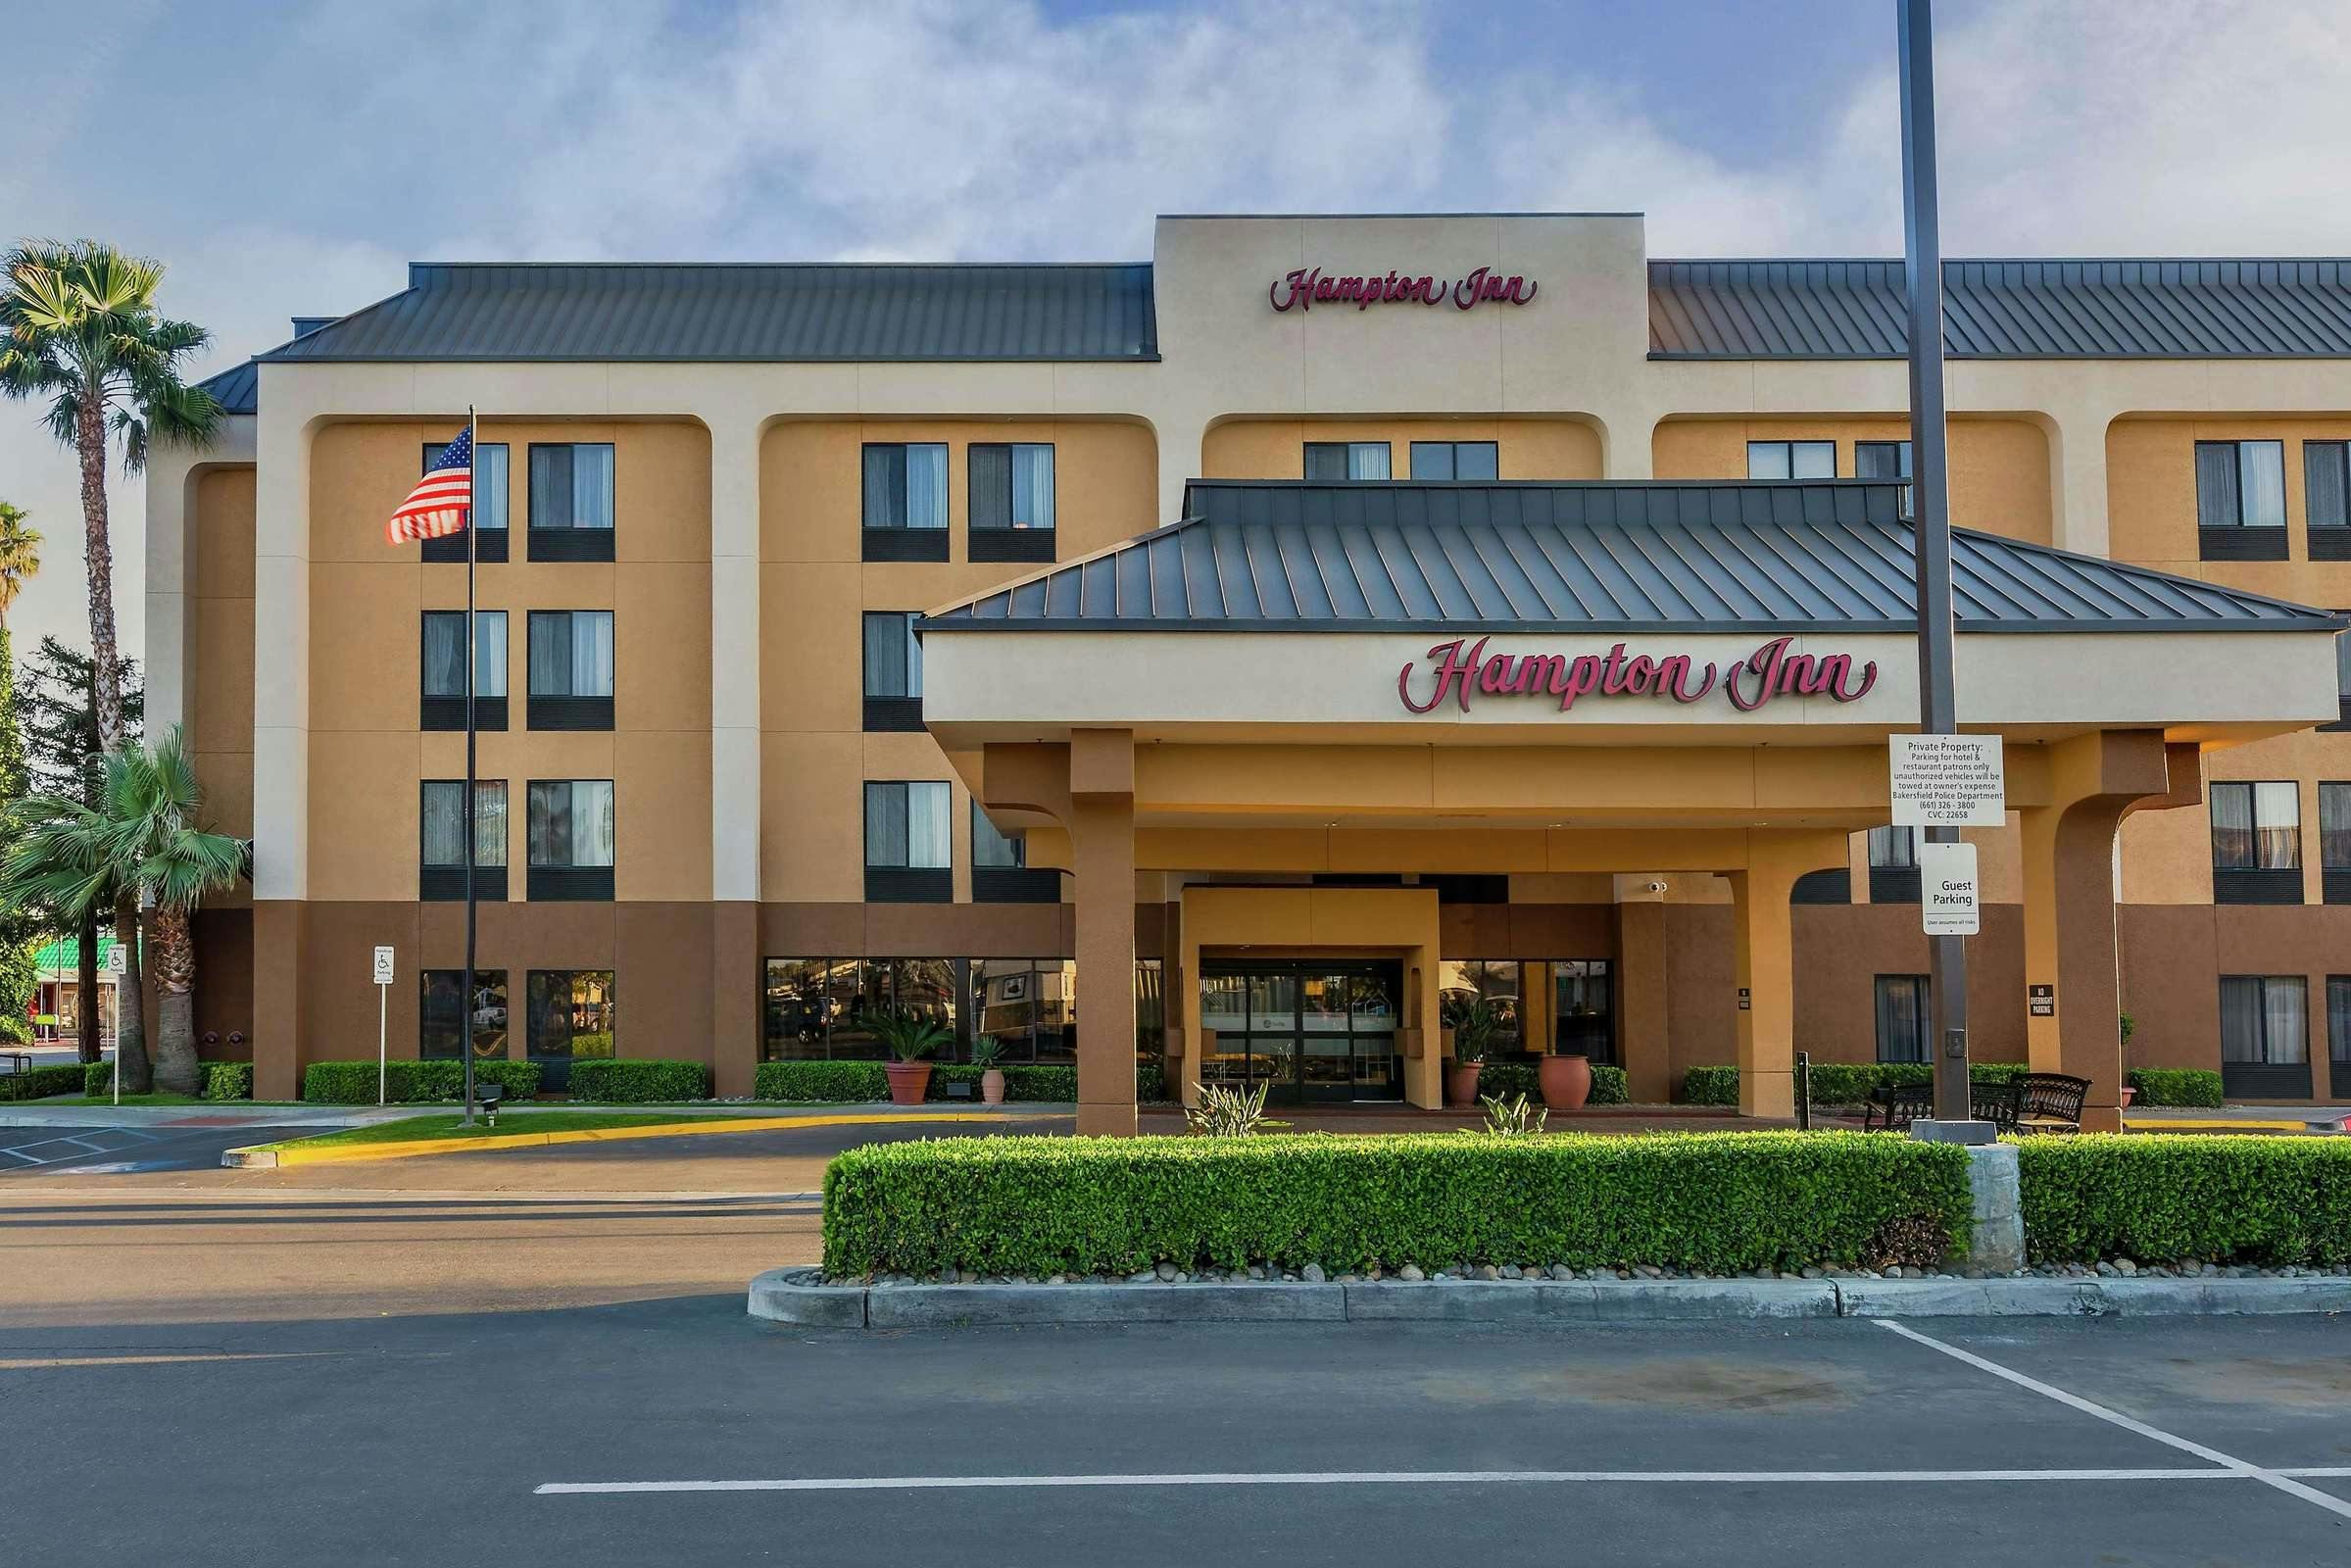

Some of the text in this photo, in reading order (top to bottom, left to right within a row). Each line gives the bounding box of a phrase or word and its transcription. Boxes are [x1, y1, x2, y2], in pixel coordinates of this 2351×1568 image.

[1269, 266, 1538, 313] Hampton Inn
[1397, 635, 1878, 714] Hampton Inn
[1908, 742, 1983, 753] Private Property:
[1911, 753, 1939, 762] Parking
[1974, 762, 1990, 771] only
[1892, 791, 1933, 800] Bakersfield
[1957, 792, 2003, 801] Department
[1919, 801, 1936, 809] (661)
[1937, 801, 1951, 809] 326
[1957, 801, 1976, 809] 3800
[1927, 810, 1969, 819] CVC: 22658
[1942, 881, 1972, 891] Guest
[1934, 894, 1972, 906] Parking
[2038, 987, 2045, 996] NO
[2030, 996, 2053, 1005] OVERNIGHT
